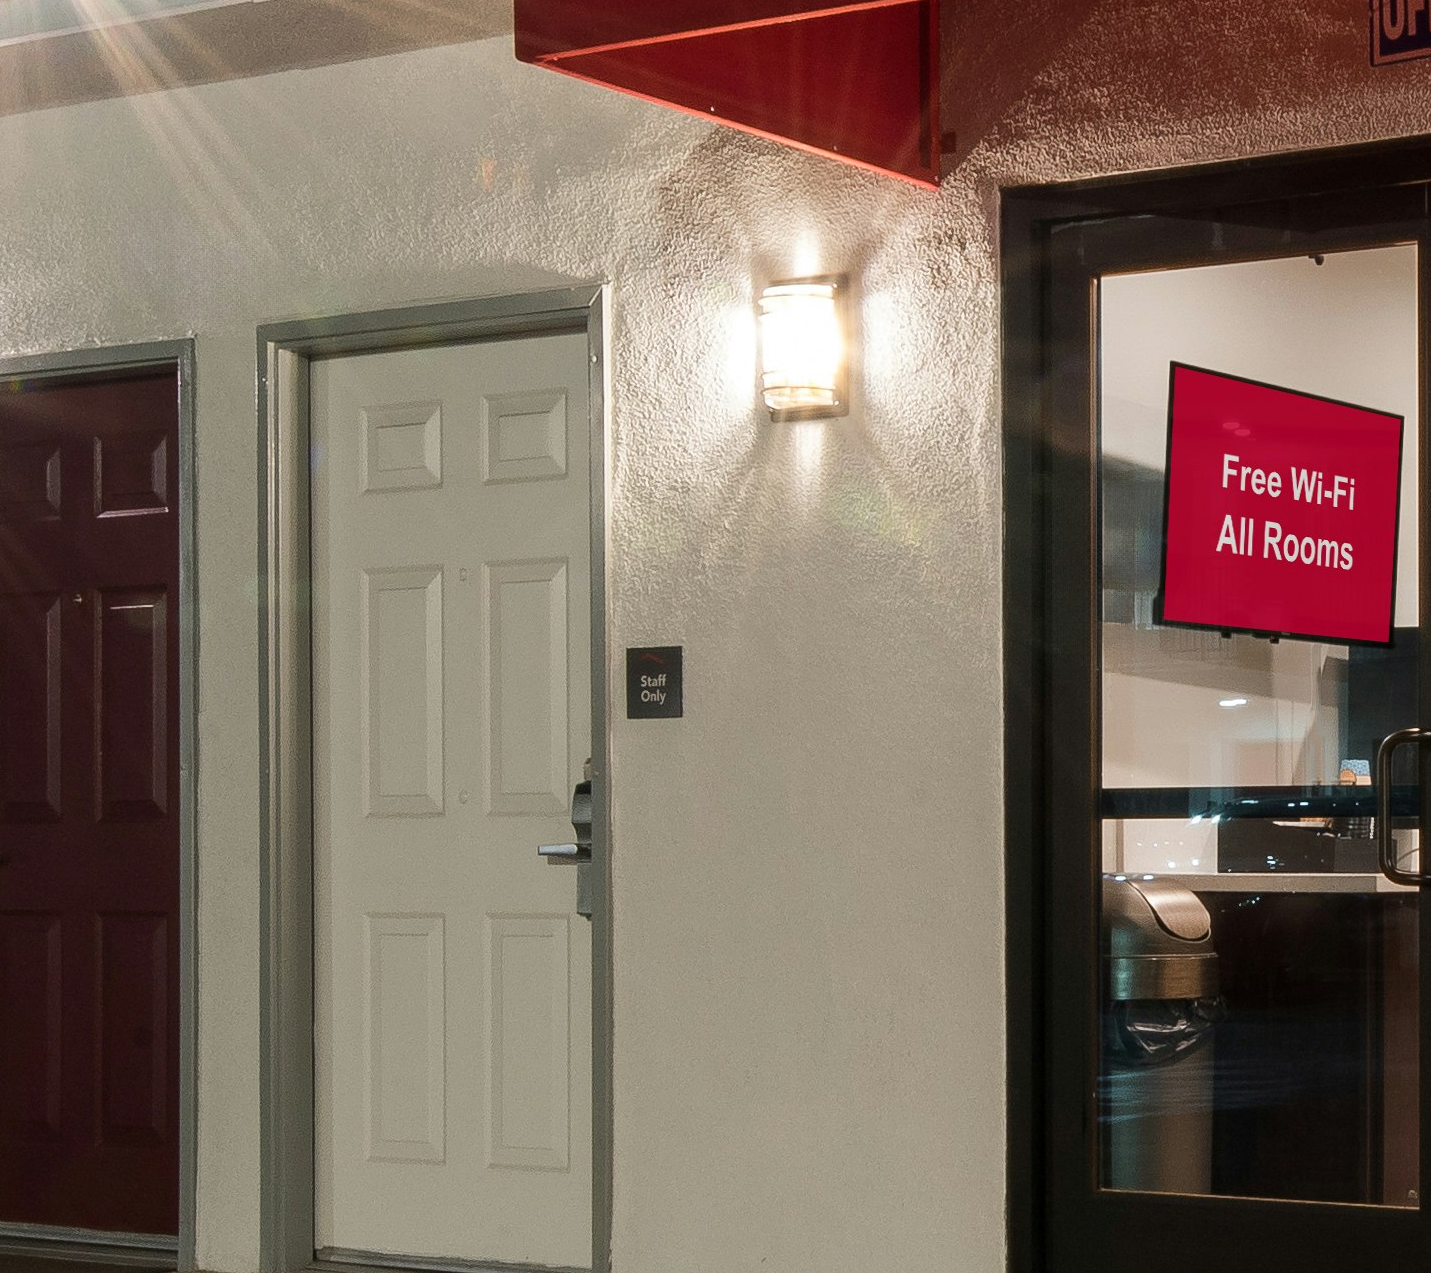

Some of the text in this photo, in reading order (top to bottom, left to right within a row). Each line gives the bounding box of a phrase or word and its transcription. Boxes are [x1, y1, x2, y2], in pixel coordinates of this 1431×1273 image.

[1221, 453, 1356, 511] Free Wi-Fi
[1215, 514, 1354, 571] All Rooms
[640, 674, 667, 688] Staff
[640, 688, 667, 705] Only
